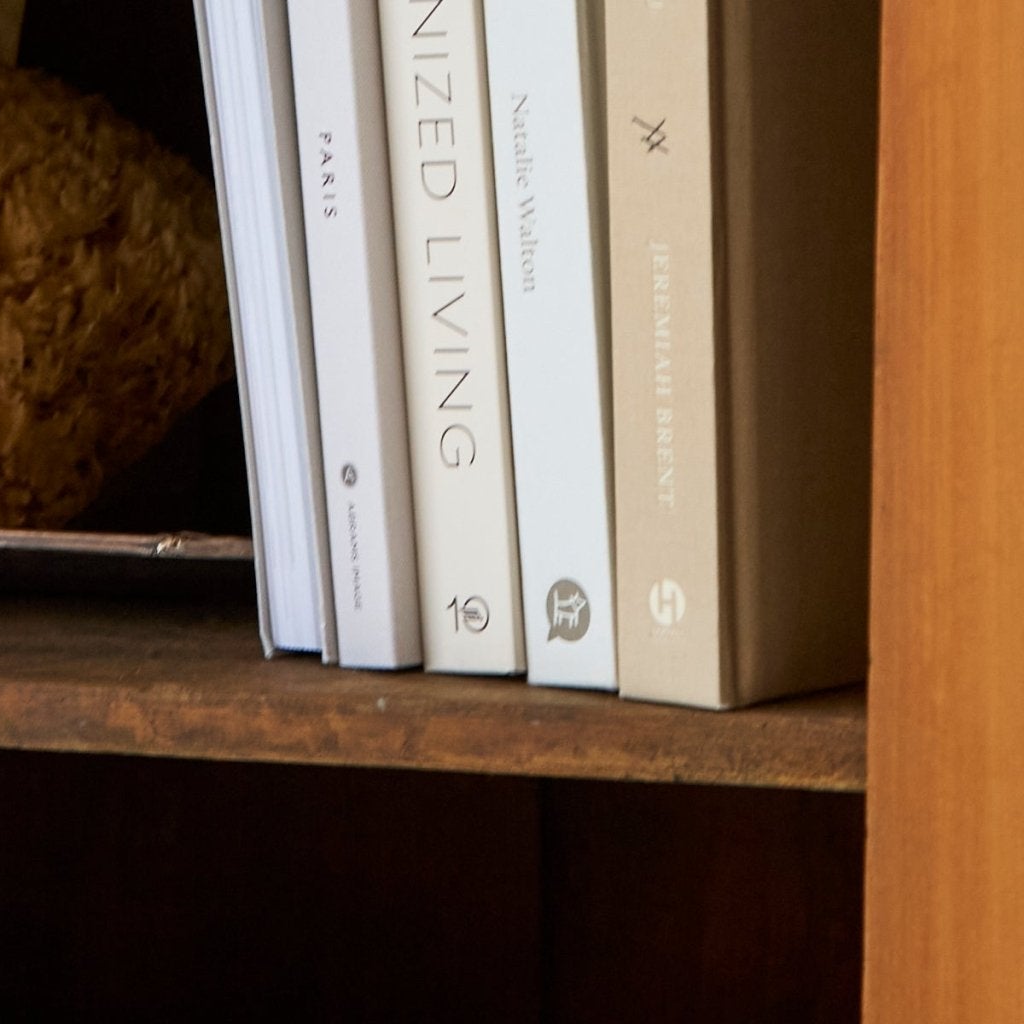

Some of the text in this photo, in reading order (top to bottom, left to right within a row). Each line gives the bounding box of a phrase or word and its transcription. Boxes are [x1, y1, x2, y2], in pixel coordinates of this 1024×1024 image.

[318, 132, 338, 219] PARIS
[511, 91, 539, 294] Natalie Walton
[425, 236, 476, 469] LIVING
[648, 238, 675, 509] JEREMIAH BRENT
